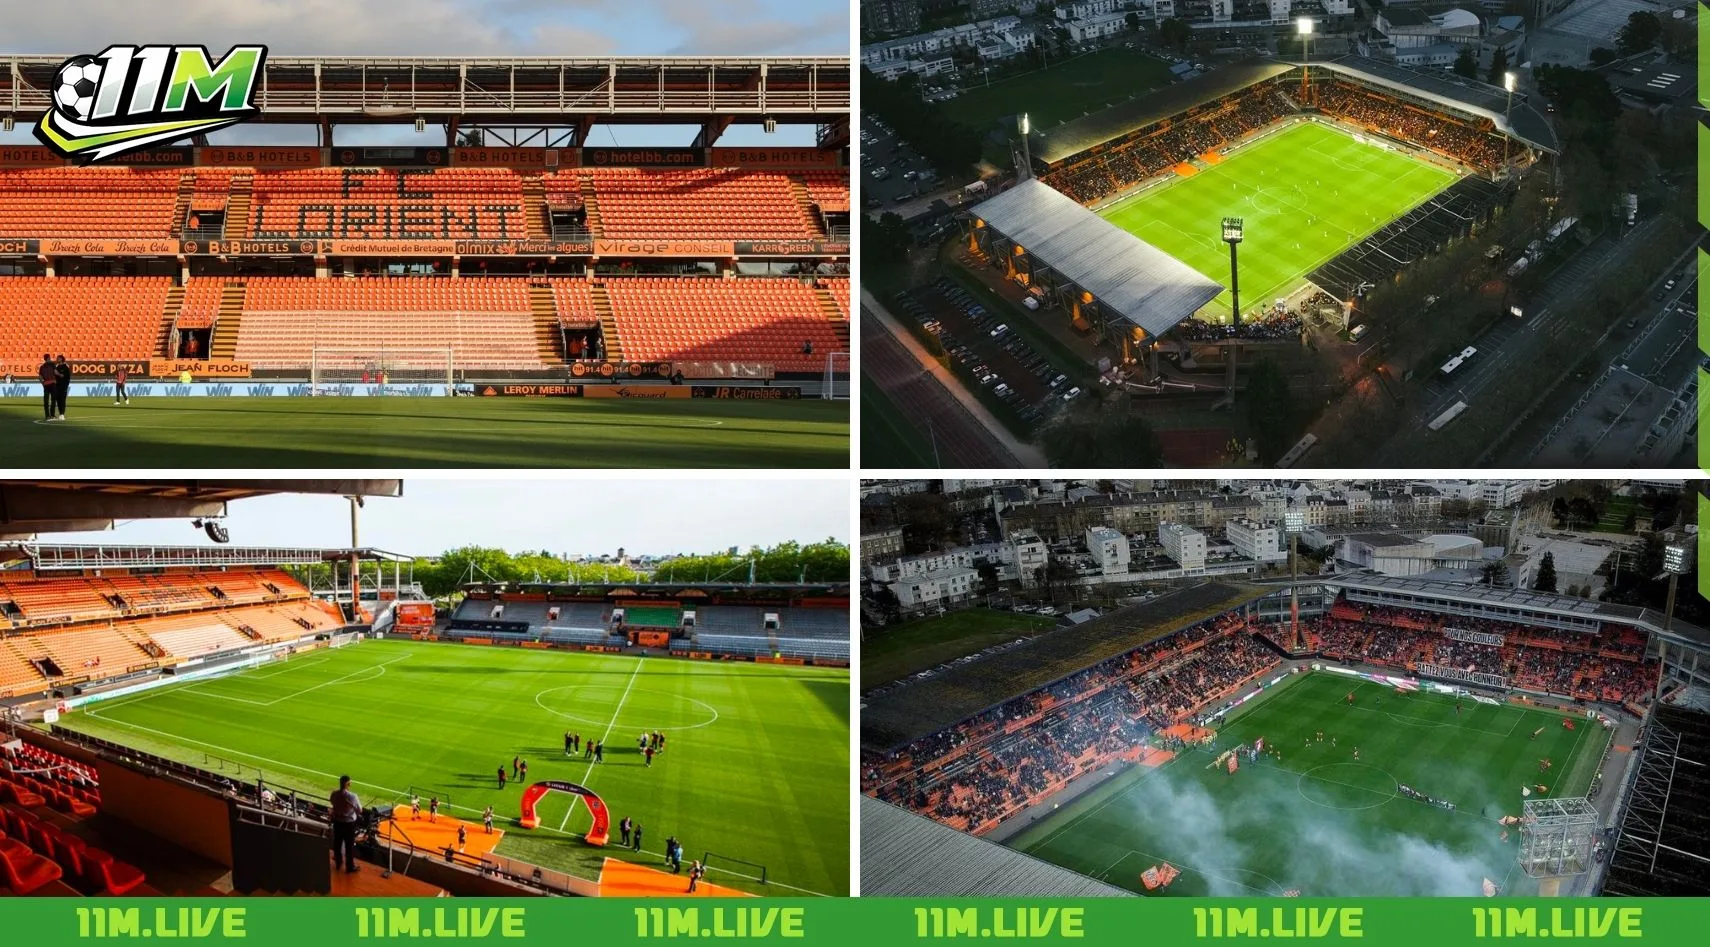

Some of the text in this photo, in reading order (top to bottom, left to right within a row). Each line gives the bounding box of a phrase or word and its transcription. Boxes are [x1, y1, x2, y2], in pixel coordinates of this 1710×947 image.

[227, 152, 255, 162] B&B
[260, 152, 311, 162] HOTELS
[460, 152, 543, 162] B&B HOTELS
[611, 151, 694, 163] hotelbb.com
[739, 152, 767, 162] B&B
[772, 152, 824, 162] HOTELS
[253, 205, 521, 238] LORIENT
[50, 241, 104, 252] Breizh Cola
[115, 241, 169, 252] Breizh Cola
[209, 241, 241, 254] B&B
[243, 243, 289, 252] HOTELS
[369, 243, 400, 252] Mutuel
[401, 244, 411, 252] de
[414, 244, 453, 254] Bretagne
[457, 241, 494, 254] olmix
[519, 242, 547, 252] Merci
[674, 244, 729, 253] CONSEIL
[72, 364, 105, 374] DOOG
[172, 364, 202, 373] JEAN
[504, 386, 577, 394] LEROY MERLIN
[733, 388, 780, 400] Carrelage
[1460, 629, 1472, 642] NOS
[1472, 631, 1503, 647] COULEURS
[1417, 662, 1439, 676] BATTEZ
[1440, 666, 1456, 679] VOUS
[1457, 668, 1474, 682] AVEC
